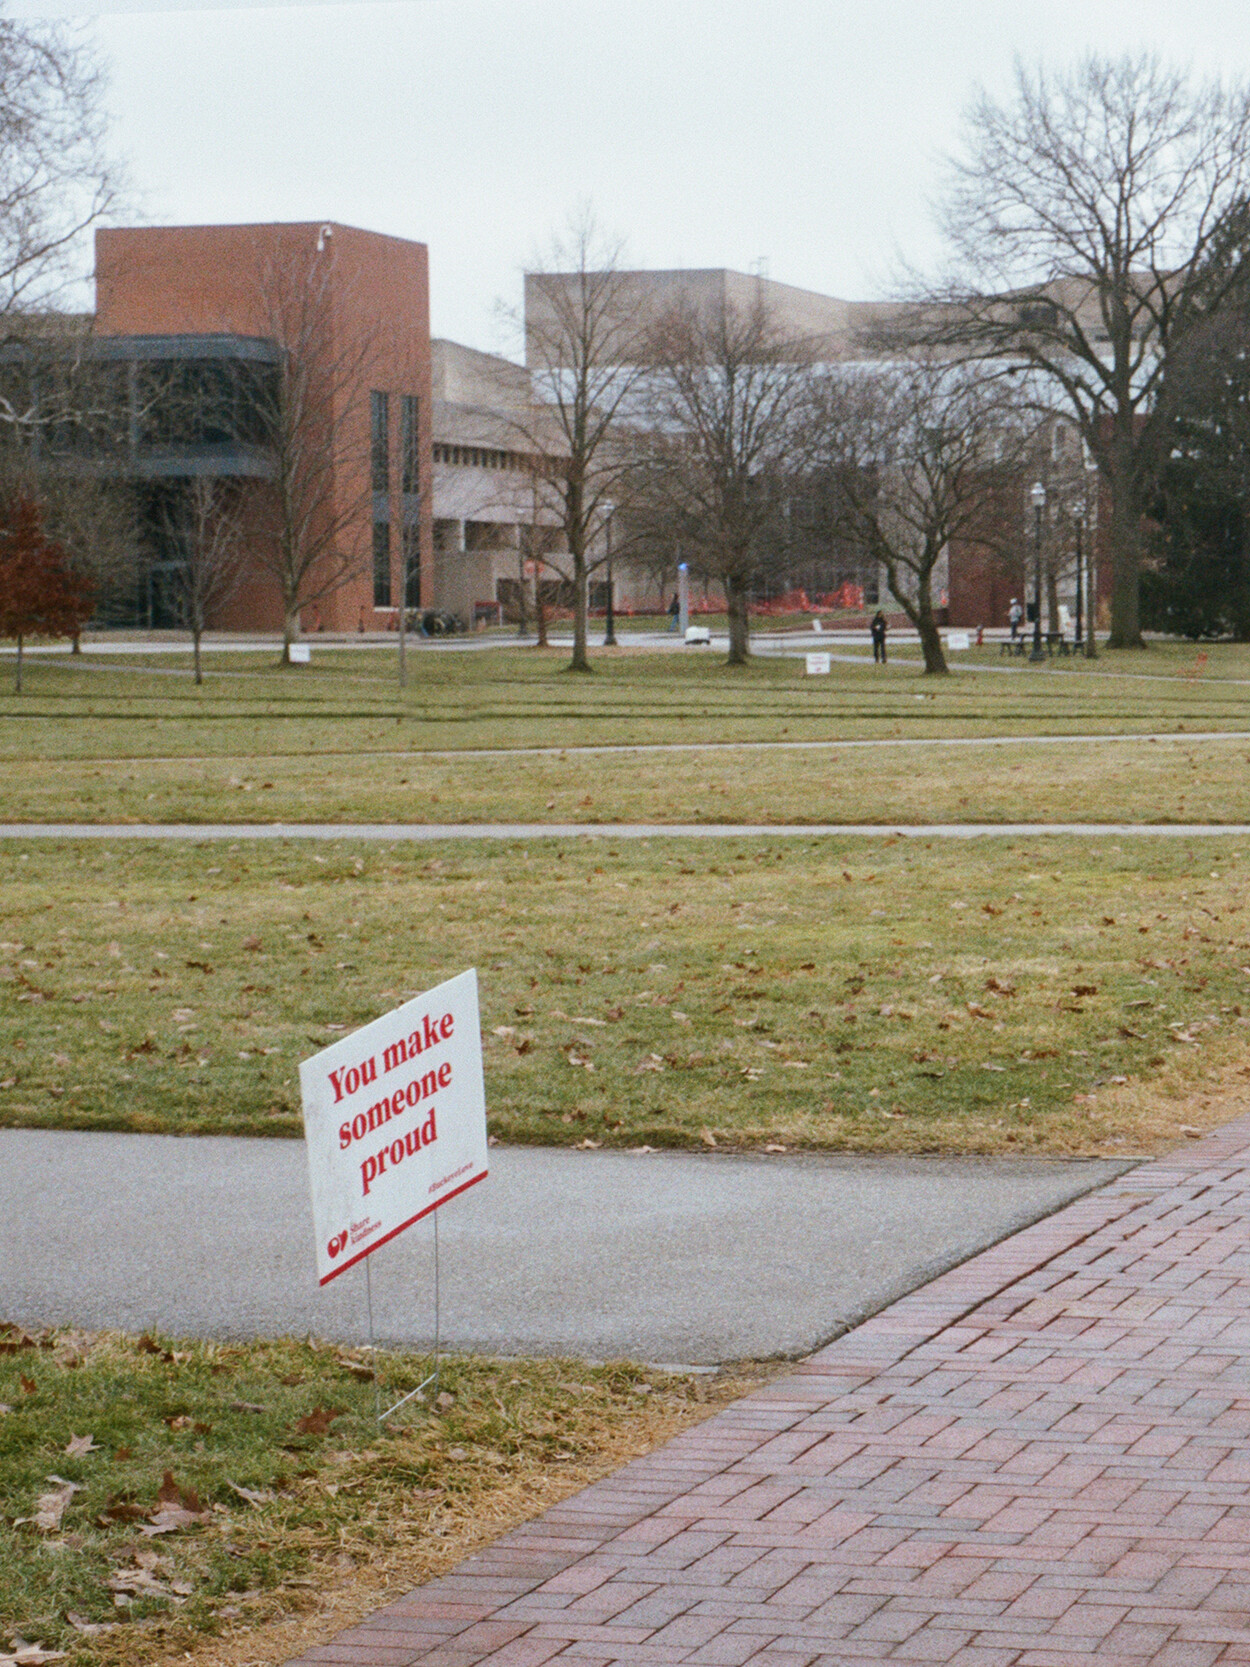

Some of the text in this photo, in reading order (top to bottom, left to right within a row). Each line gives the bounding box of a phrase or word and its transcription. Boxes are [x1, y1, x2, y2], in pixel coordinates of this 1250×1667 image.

[327, 1012, 455, 1104] You make
[338, 1061, 452, 1150] someone
[359, 1107, 438, 1197] proud
